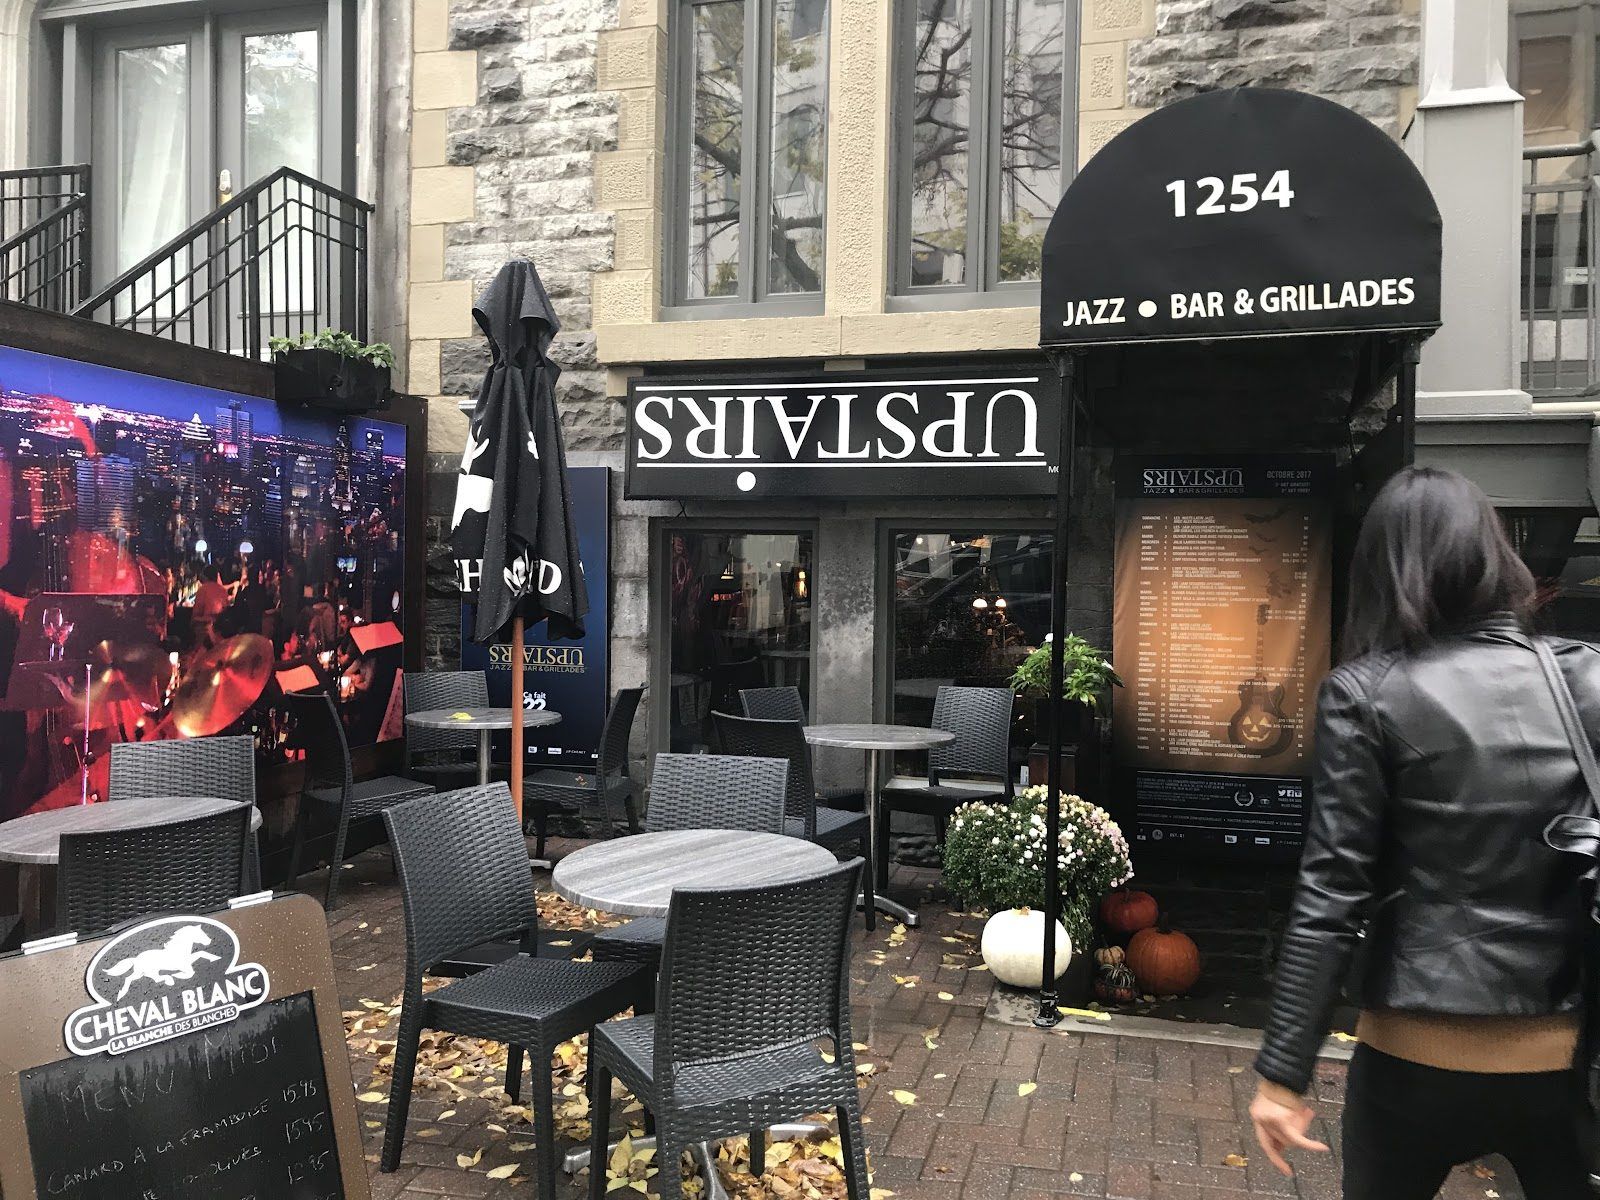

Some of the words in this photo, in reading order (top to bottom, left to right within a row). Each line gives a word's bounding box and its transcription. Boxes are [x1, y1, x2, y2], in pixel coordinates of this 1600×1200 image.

[1165, 169, 1295, 218] 1254
[1063, 297, 1126, 327] JAZZ
[1170, 291, 1225, 319] BAR
[1234, 288, 1254, 315] &
[1260, 277, 1415, 313] GRILLADES
[634, 389, 1045, 460] UPSTAIRS
[1143, 469, 1244, 487] UPSTAIRS
[1266, 470, 1295, 479] OCTOBRE
[1296, 470, 1312, 479] 2017
[489, 646, 584, 665] UPSTARS
[534, 691, 546, 699] fait
[74, 996, 176, 1043] CHEVAL
[181, 971, 262, 1014] BLANC
[111, 1041, 125, 1051] LA
[127, 1026, 173, 1047] BLANCHE
[175, 1021, 190, 1034] DES
[192, 1007, 235, 1028] BLANCHES
[60, 1069, 174, 1124] MENU
